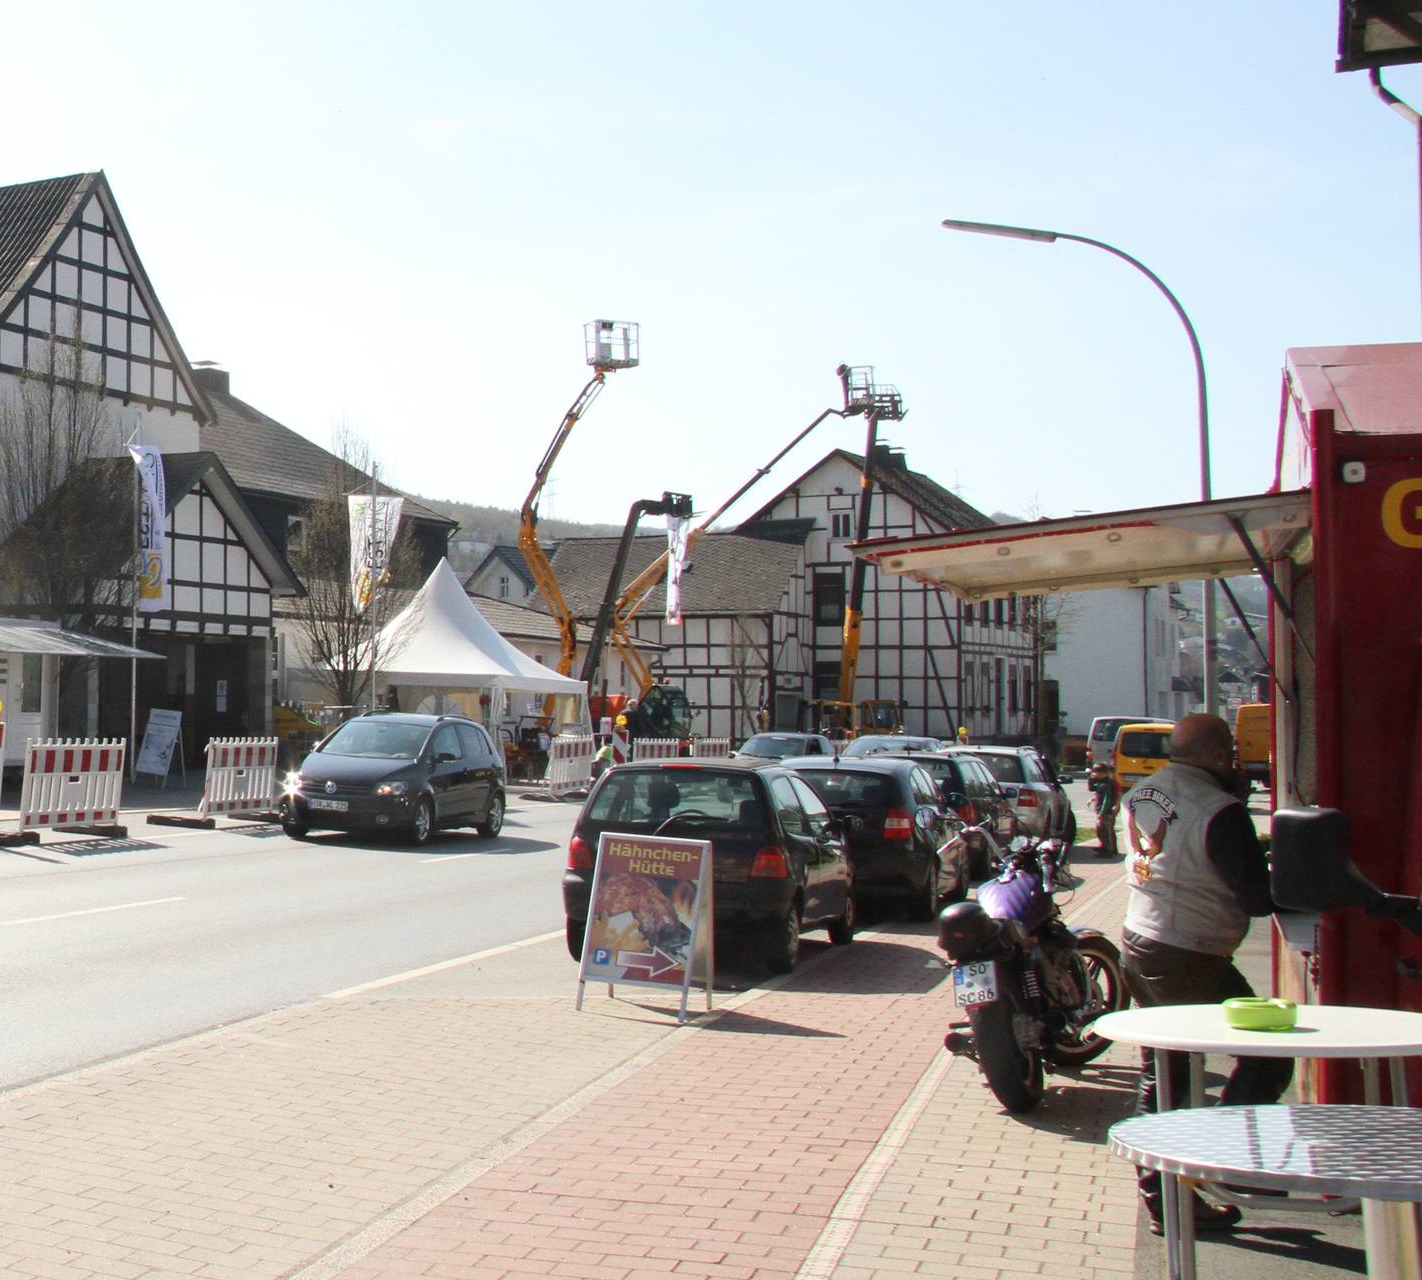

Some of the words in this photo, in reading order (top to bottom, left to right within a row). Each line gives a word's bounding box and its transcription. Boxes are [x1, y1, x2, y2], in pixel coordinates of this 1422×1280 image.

[609, 842, 698, 862] Hähnchen-
[629, 859, 675, 876] Hütte
[969, 963, 986, 976] SO
